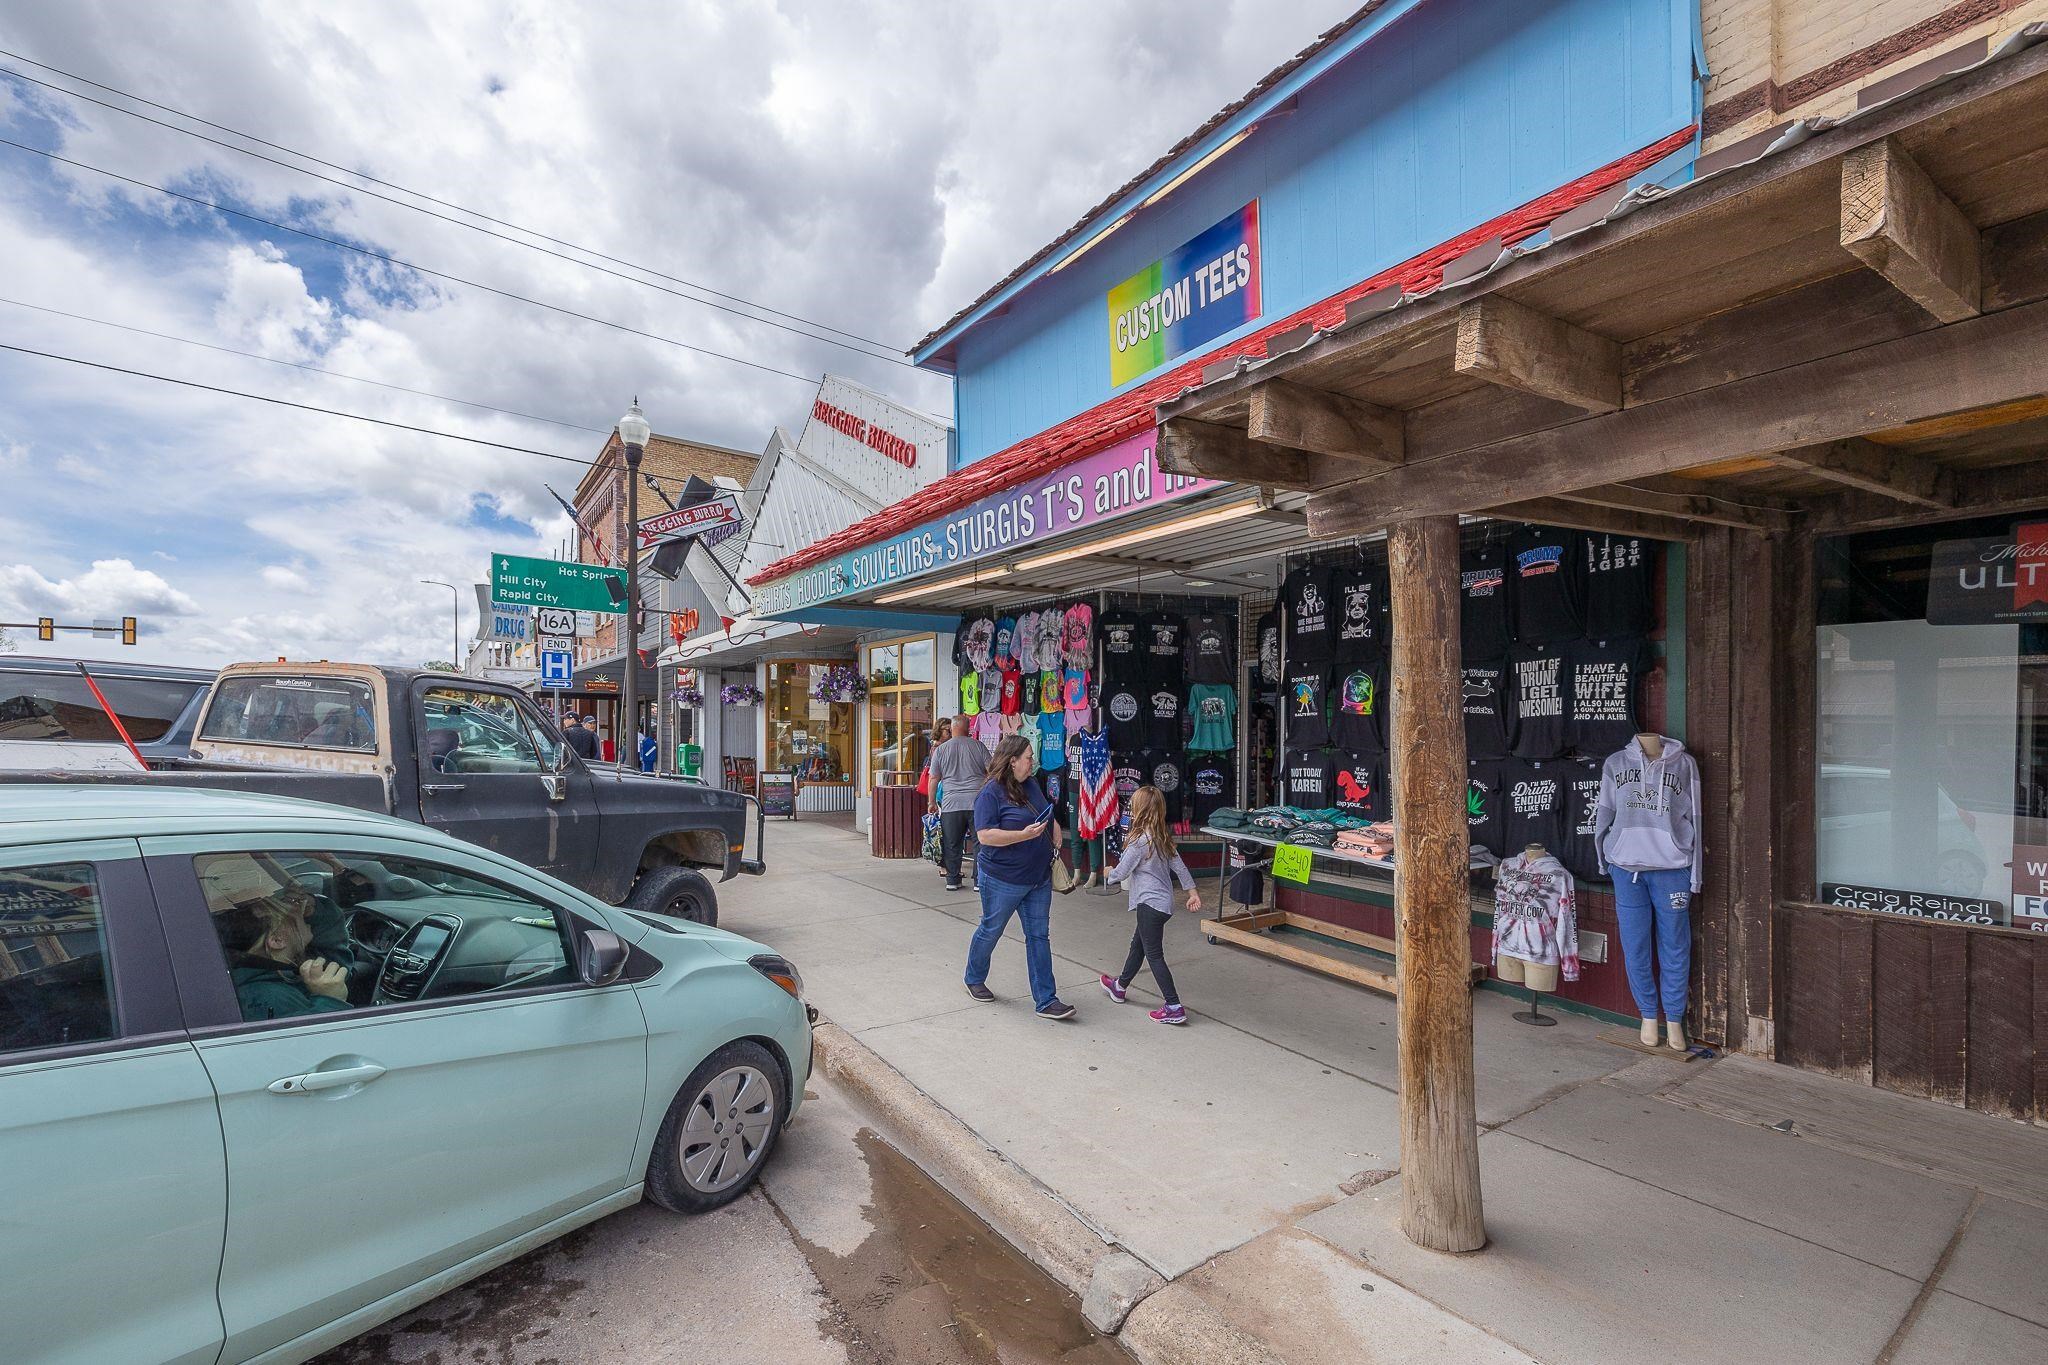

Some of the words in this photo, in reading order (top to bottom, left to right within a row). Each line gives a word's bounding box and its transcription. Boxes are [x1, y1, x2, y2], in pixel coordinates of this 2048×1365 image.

[1115, 276, 1191, 352] CUSTOM
[1195, 243, 1251, 309] TEES
[812, 399, 866, 443] BEGGING
[866, 423, 917, 469] BURRO
[692, 504, 723, 521] BURRO
[752, 582, 791, 617] T-SHIRTS
[946, 494, 1035, 561] STURGIS
[1042, 475, 1084, 529] T'S
[1094, 448, 1151, 513] and
[1517, 546, 1563, 567] TRUMP
[559, 567, 577, 577] Hot
[582, 571, 619, 581] Sprin
[1462, 568, 1503, 583] TRUMP
[500, 575, 518, 584] Hill
[524, 577, 546, 588] City
[500, 589, 530, 600] Rapid
[536, 592, 558, 603] City
[1469, 587, 1494, 597] 2024
[496, 616, 525, 637] DRUG
[543, 614, 570, 629] 16A
[1342, 629, 1371, 639] BACK!
[547, 640, 567, 648] END
[546, 654, 568, 678] H
[1516, 663, 1518, 673] I
[1520, 660, 1546, 672] DON'T
[1548, 658, 1560, 669] GE
[1576, 664, 1580, 673] I
[1584, 664, 1615, 673] HAVE
[1619, 663, 1628, 672] A
[1469, 669, 1498, 677] Weiner
[1575, 673, 1628, 682] BEAUTIFUL
[1522, 688, 1526, 700] I
[1530, 684, 1558, 699] GET
[1575, 682, 1627, 699] WIFE
[1519, 697, 1562, 718] AWESOME!
[1291, 768, 1303, 777] NOT
[1303, 768, 1322, 777] TODAY
[1615, 769, 1641, 789] BLACK
[1291, 779, 1322, 792] KAREN
[1472, 779, 1488, 792] PANIC
[1511, 781, 1556, 797] Drunk
[1573, 782, 1576, 790] I
[1524, 804, 1539, 812] LIKE
[1647, 804, 1669, 812] DAKTA
[1468, 814, 1489, 825] RGANIC
[1277, 848, 1288, 864] 2
[1835, 887, 1899, 906] Craig
[1910, 895, 1989, 915] Reindl
[1526, 905, 1544, 918] COW
